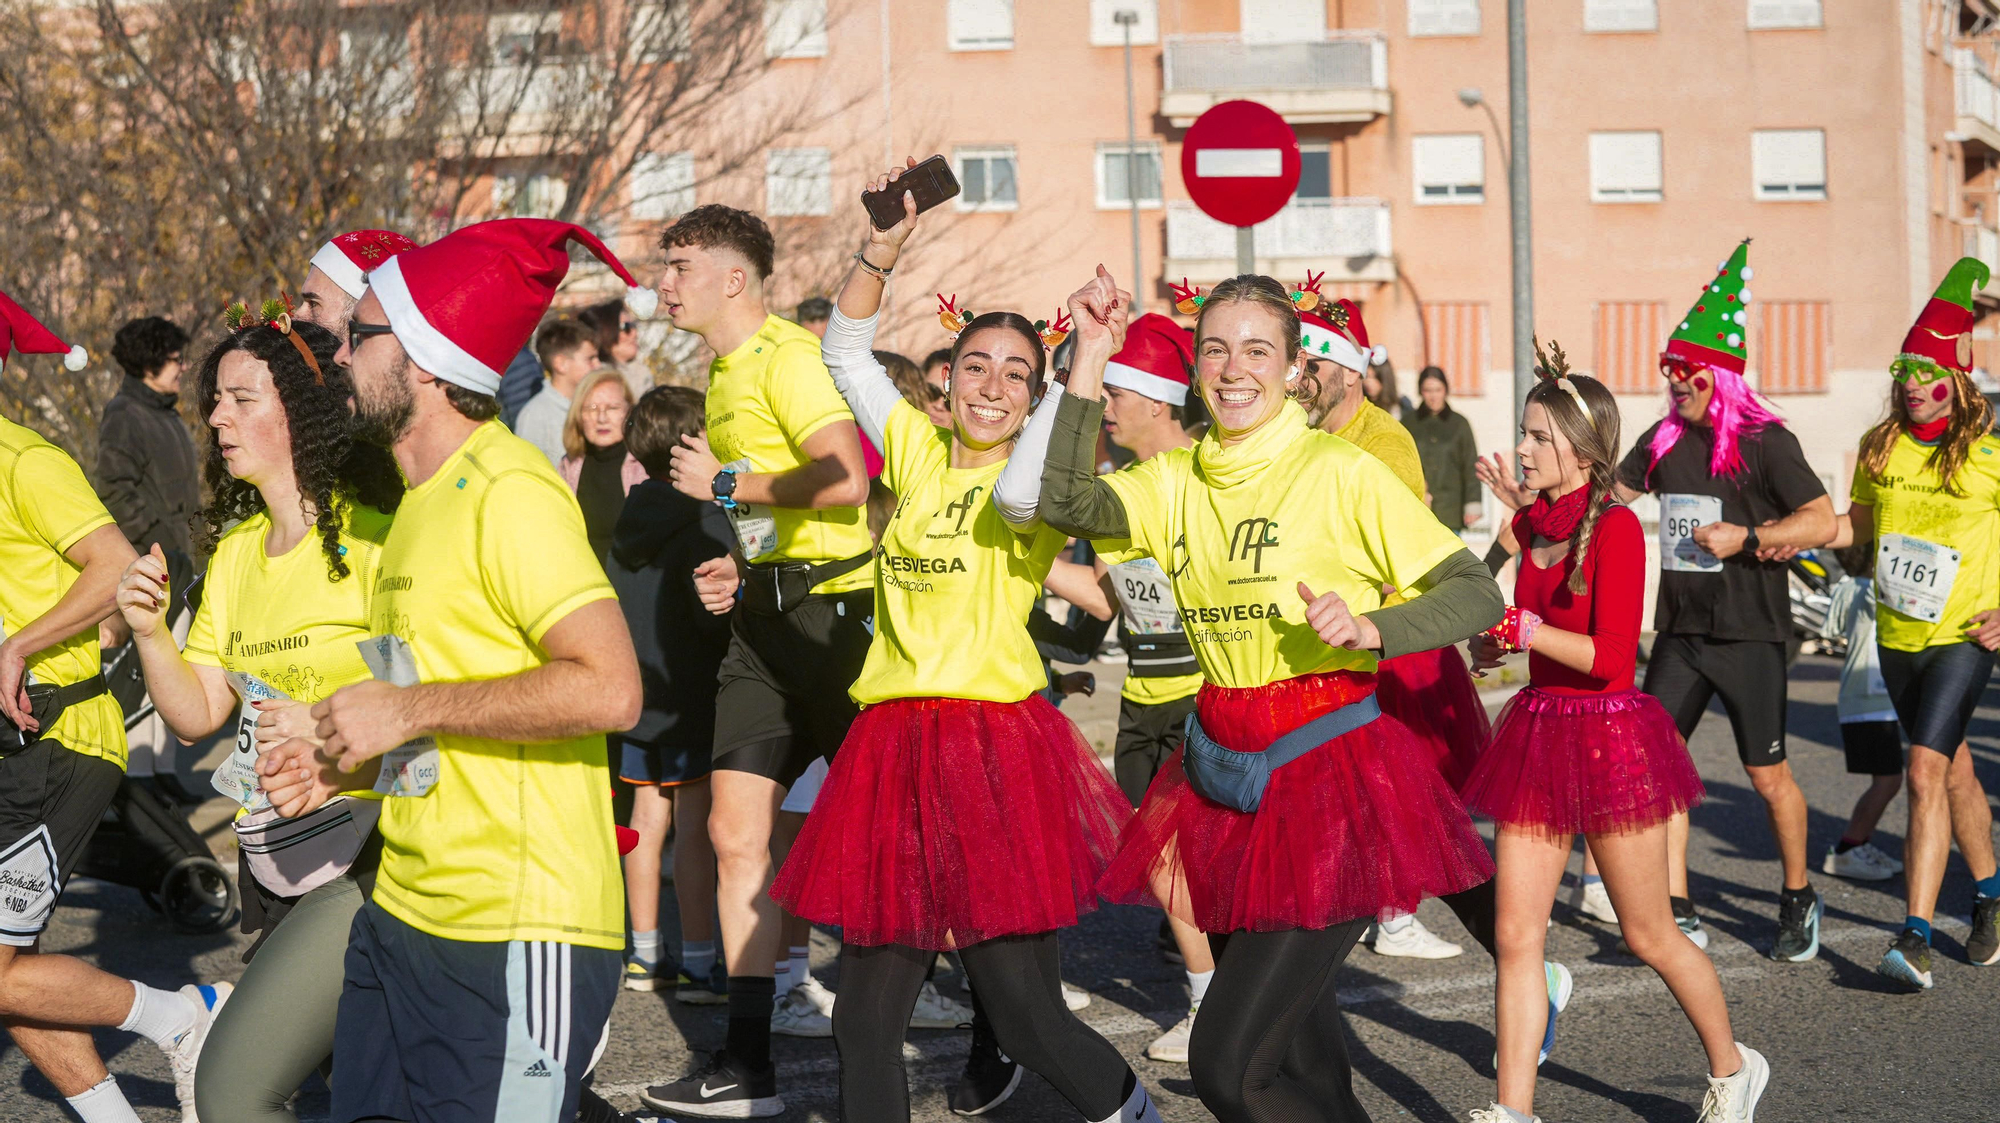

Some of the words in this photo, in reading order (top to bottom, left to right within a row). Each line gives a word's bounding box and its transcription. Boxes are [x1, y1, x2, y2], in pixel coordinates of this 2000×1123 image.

[1228, 575, 1278, 586] www.doctorcaracuel.es
[1890, 556, 1938, 587] 1161
[1125, 578, 1161, 604] 924
[1176, 603, 1283, 624] RESVEGA
[1194, 626, 1253, 644] dificación
[239, 635, 309, 658] ANIVERSARIO
[0, 870, 46, 893] Basketball
[10, 896, 28, 913] NBA
